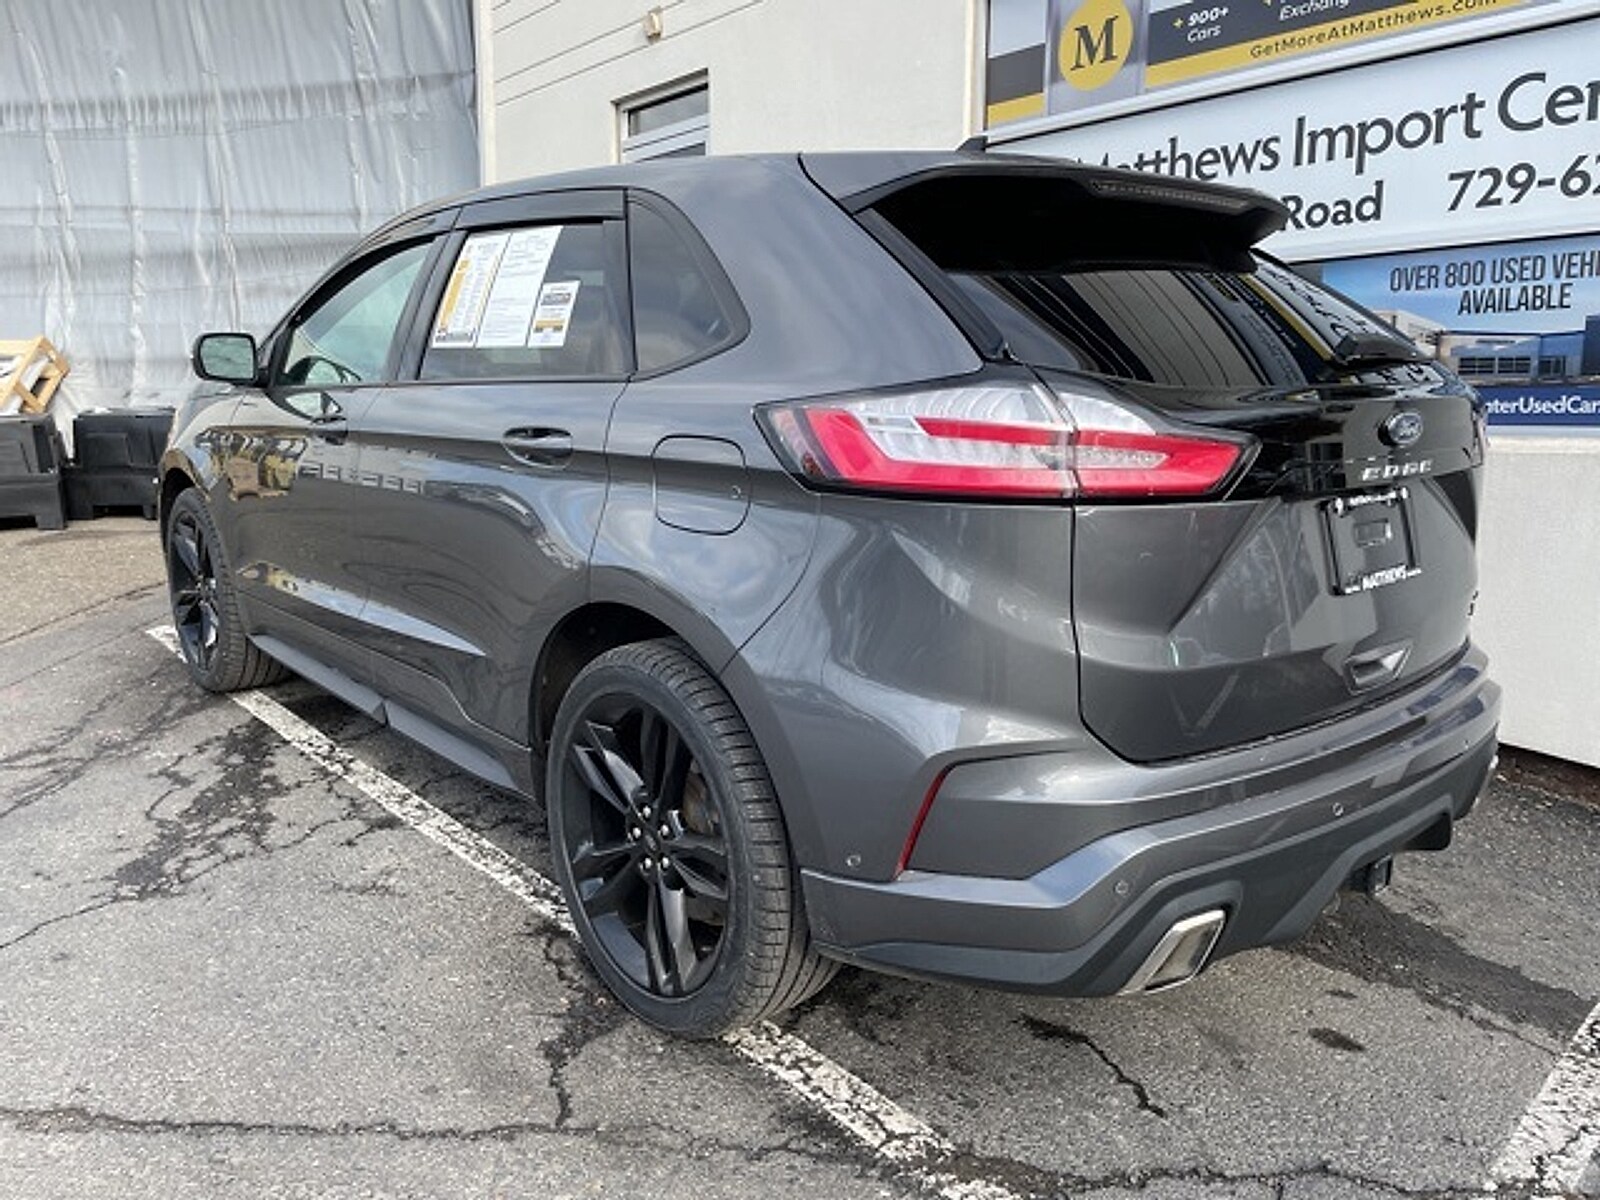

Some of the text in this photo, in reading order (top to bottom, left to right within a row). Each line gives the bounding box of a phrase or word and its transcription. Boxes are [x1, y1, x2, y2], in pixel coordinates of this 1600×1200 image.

[1070, 15, 1119, 71] M
[1186, 25, 1222, 43] Cars
[1077, 135, 1281, 182] tthews
[1293, 91, 1486, 175] Import
[1280, 179, 1384, 231] Road
[1390, 264, 1440, 292] OVER
[1445, 259, 1487, 289] 800
[1490, 254, 1547, 285] USED
[1457, 282, 1574, 316] AVAILABLE
[1361, 459, 1433, 481] EDGE
